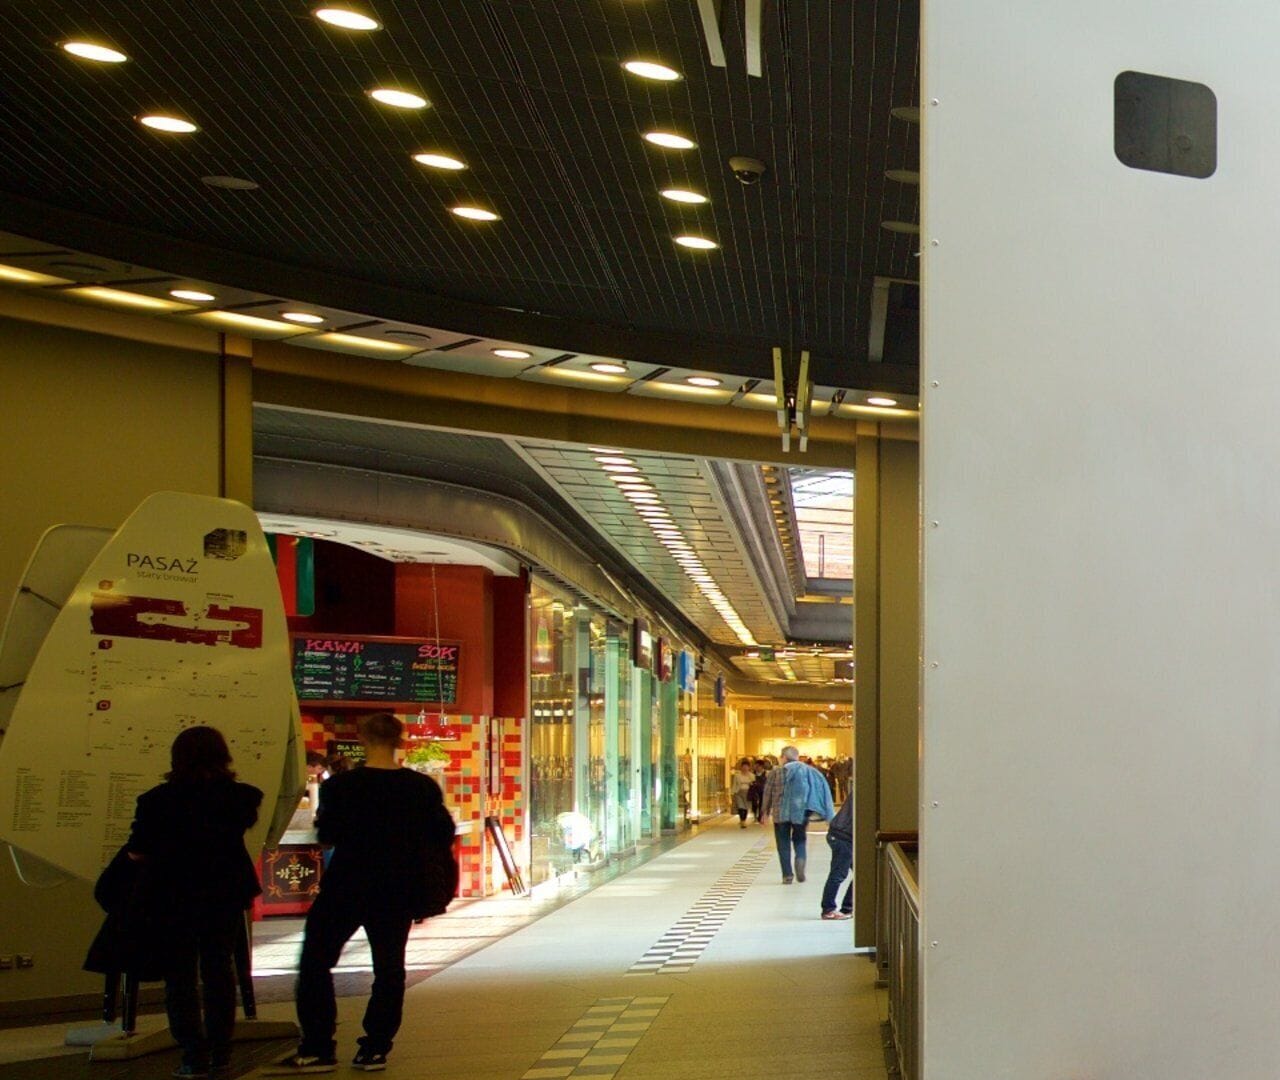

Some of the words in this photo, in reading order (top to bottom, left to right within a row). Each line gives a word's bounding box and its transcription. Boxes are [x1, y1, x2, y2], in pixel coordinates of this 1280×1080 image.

[127, 553, 199, 574] PASAŻ
[137, 571, 161, 580] stary
[163, 573, 198, 583] browar
[417, 644, 457, 660] SOK
